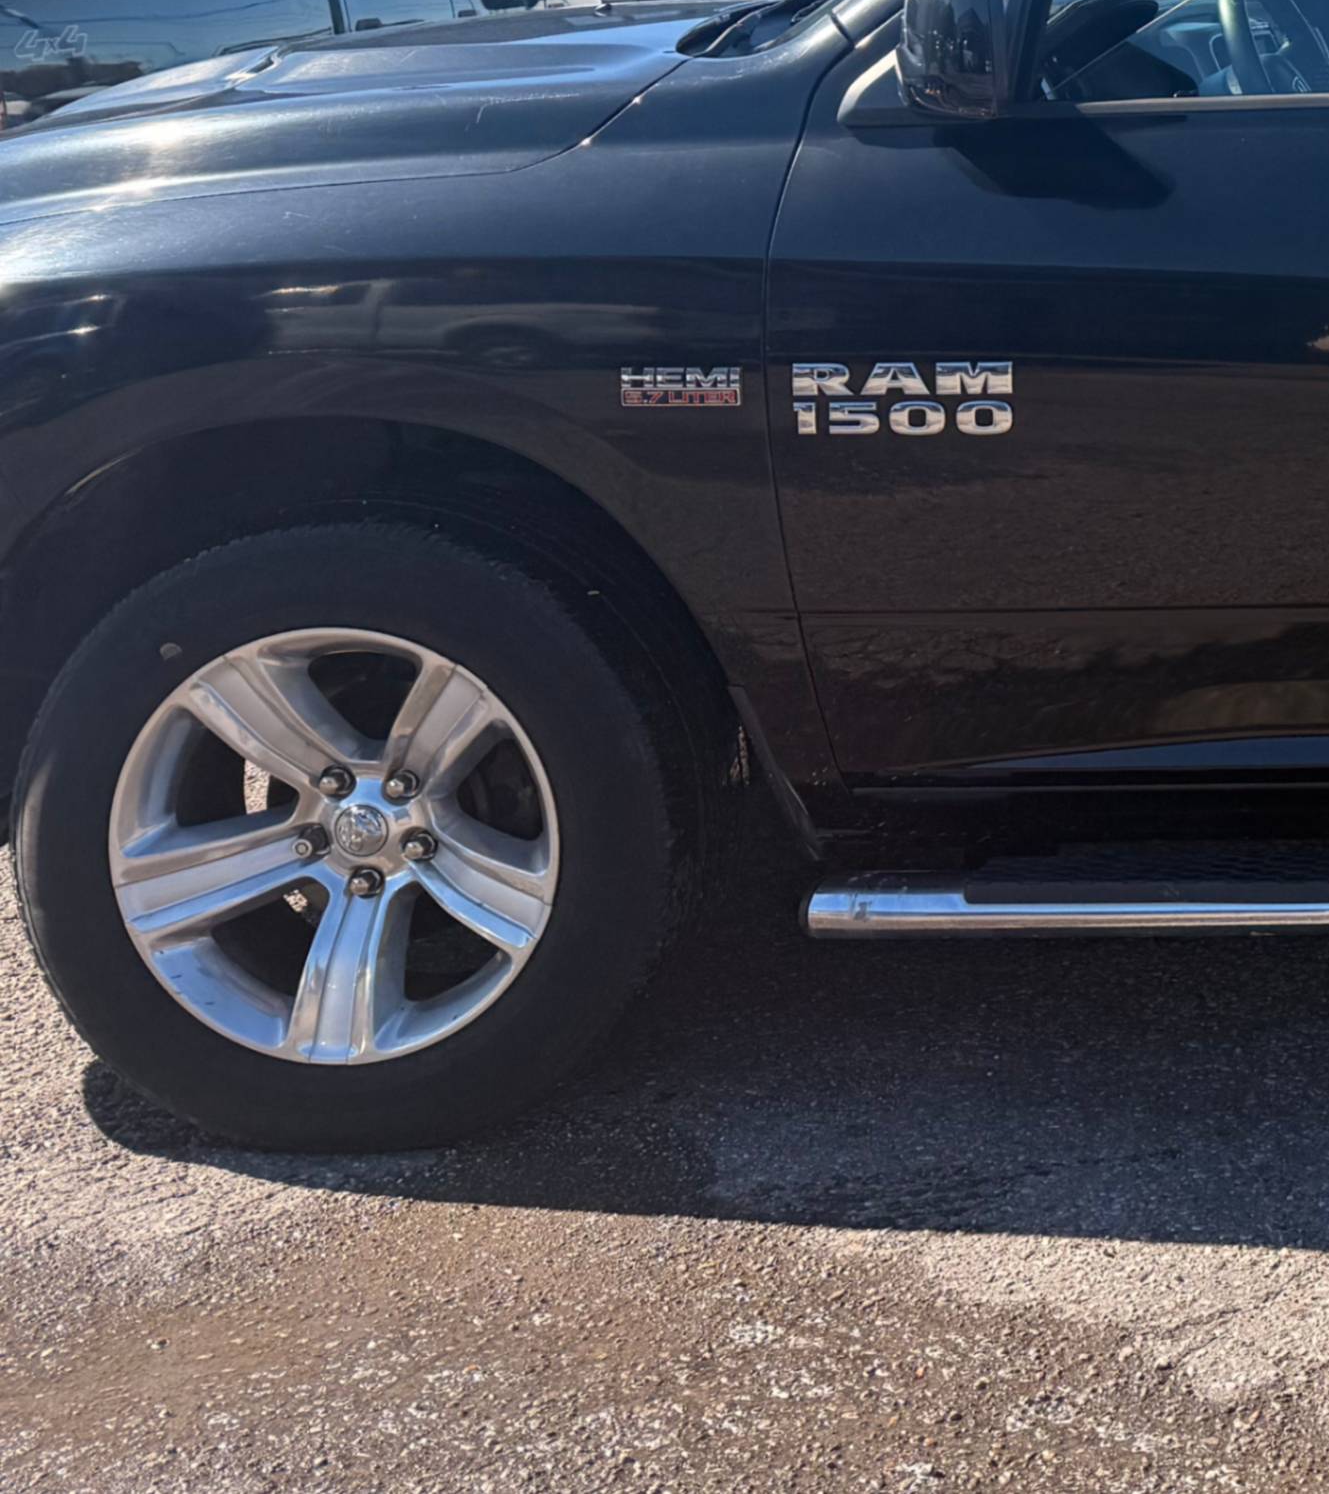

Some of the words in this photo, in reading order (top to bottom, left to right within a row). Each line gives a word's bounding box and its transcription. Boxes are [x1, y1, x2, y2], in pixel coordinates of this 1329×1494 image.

[14, 24, 88, 62] 4x4
[620, 367, 740, 388] HEMI
[791, 361, 1014, 396] RAM
[624, 390, 664, 404] 5.7
[667, 390, 737, 404] LITER
[792, 400, 1014, 436] 1500
